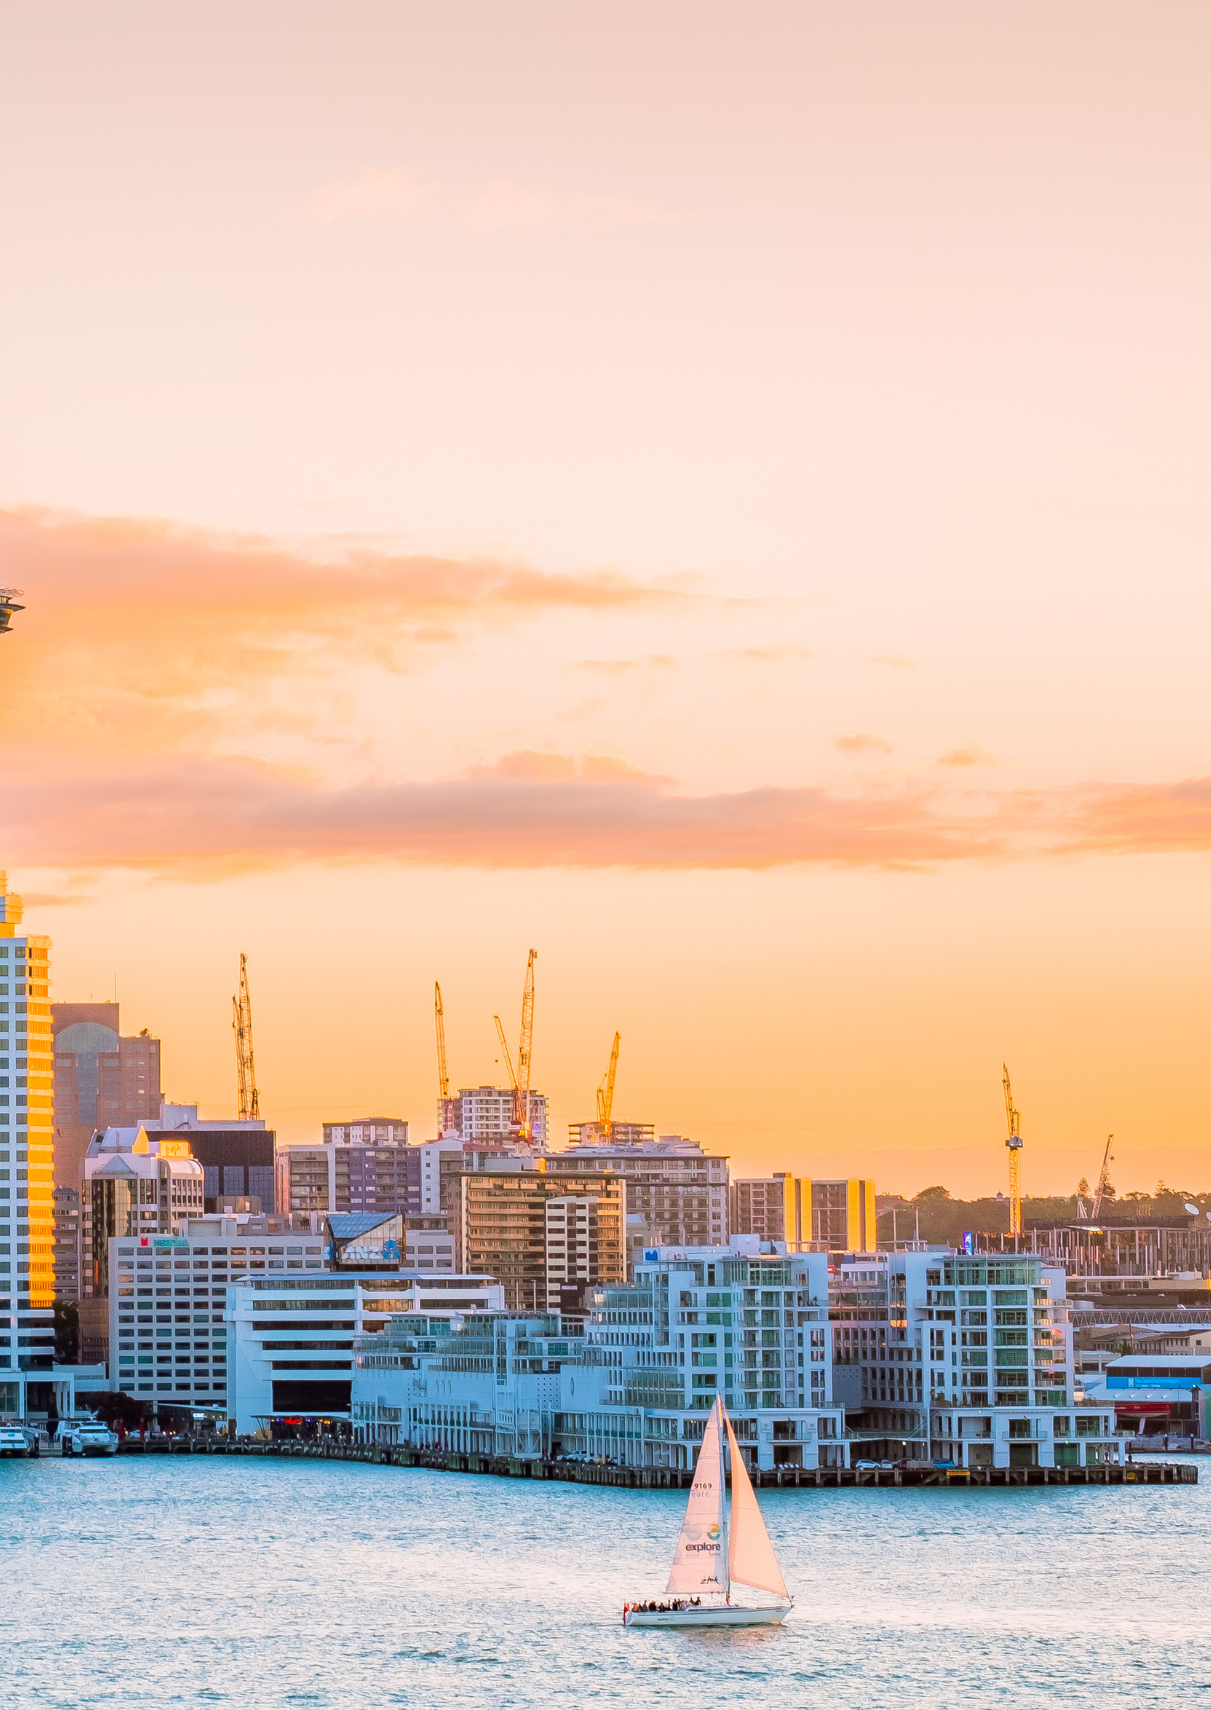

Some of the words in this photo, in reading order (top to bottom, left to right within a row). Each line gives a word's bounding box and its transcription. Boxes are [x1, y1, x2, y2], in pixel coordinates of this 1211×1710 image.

[341, 1245, 381, 1260] ANZ
[694, 1482, 713, 1490] 9169
[685, 1542, 721, 1553] explore
